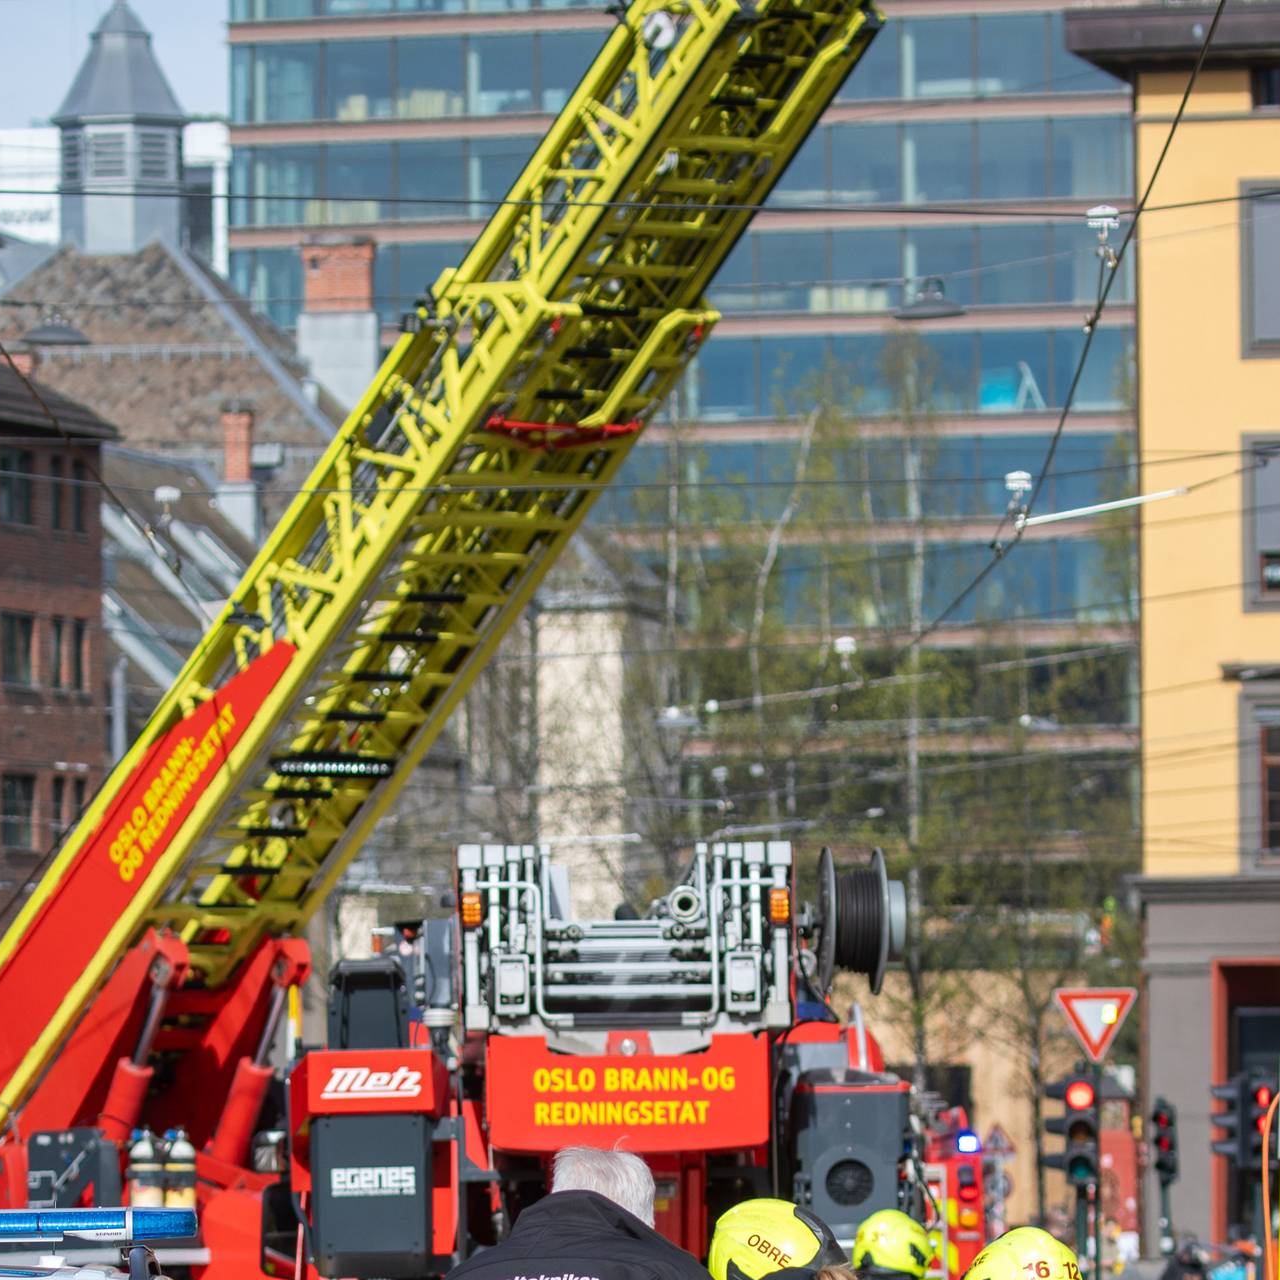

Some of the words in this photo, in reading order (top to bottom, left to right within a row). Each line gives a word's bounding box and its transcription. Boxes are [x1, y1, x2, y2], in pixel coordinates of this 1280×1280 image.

[119, 845, 144, 882] OG
[139, 702, 236, 853] REDNINGSETAT
[109, 805, 148, 864] OSLO
[320, 1065, 422, 1099] Metz
[533, 1068, 596, 1093] OSLO
[534, 1101, 710, 1127] REDNINGSETAT
[747, 1233, 792, 1270] OBRE
